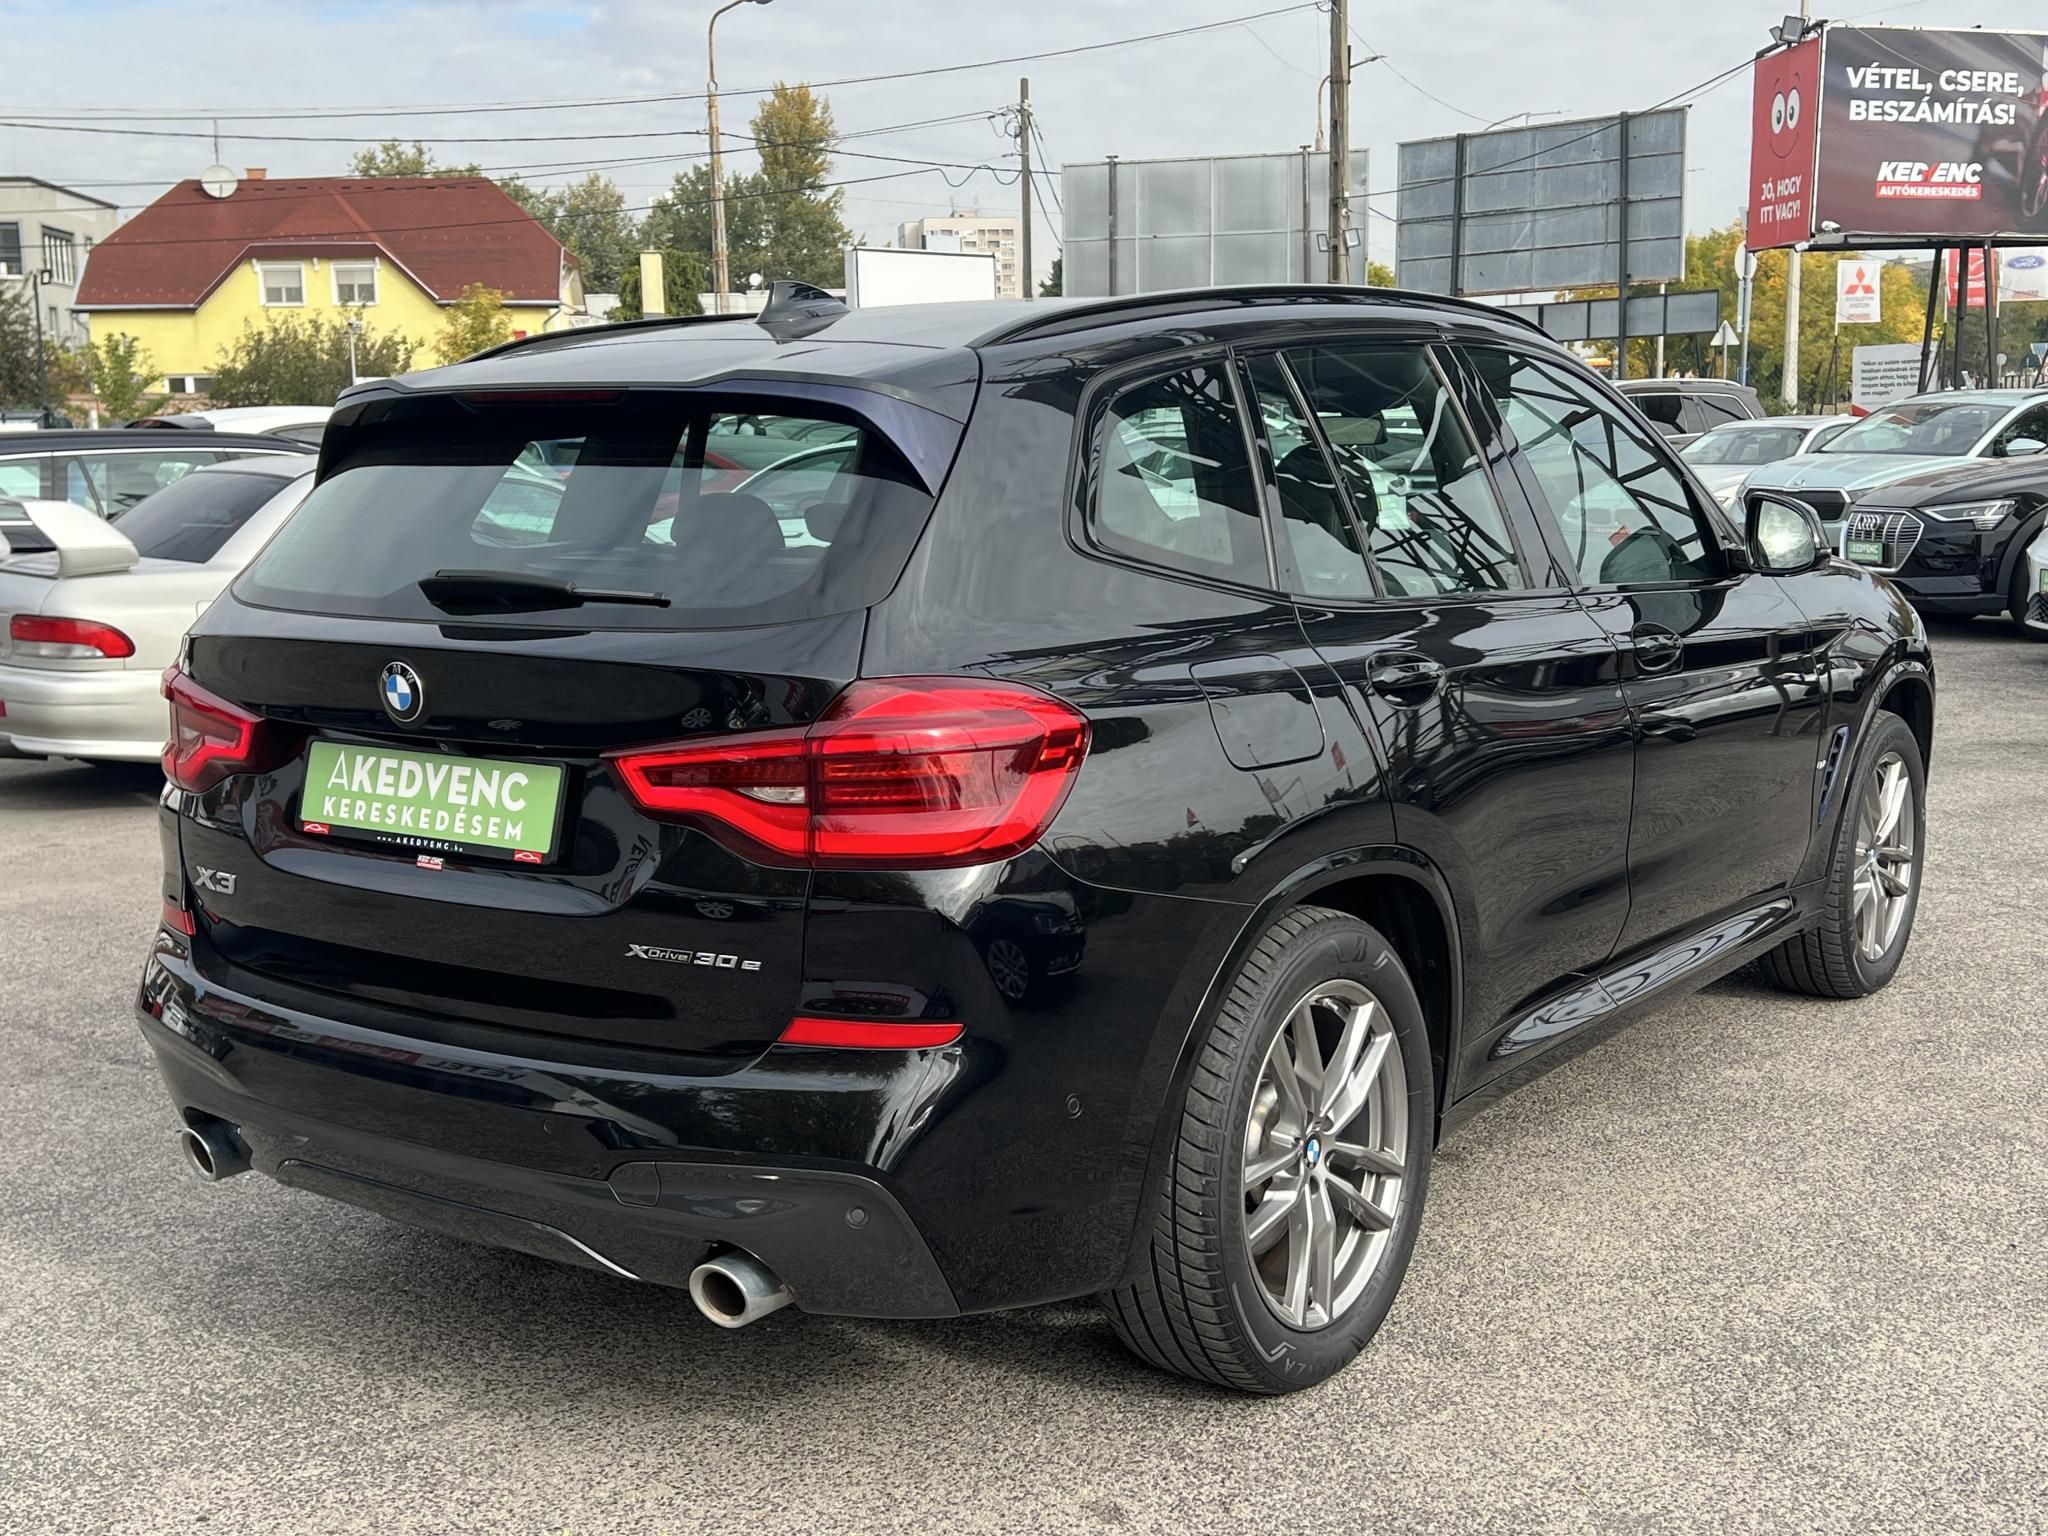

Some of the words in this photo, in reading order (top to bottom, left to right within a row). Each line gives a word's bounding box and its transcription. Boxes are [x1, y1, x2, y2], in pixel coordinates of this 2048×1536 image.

[1846, 61, 1933, 95] VÉTEL,
[1939, 69, 2025, 98] CSERE,
[1849, 96, 2017, 125] BESZÁMÍTÁS!
[1760, 177, 1775, 202] JÓ,
[1776, 174, 1802, 198] HOGY
[1879, 184, 1979, 197] AUTÓKERESKEDÉS
[1760, 205, 1774, 225] ITT
[1775, 199, 1801, 221] VAGY!
[381, 664, 416, 685] BMW
[323, 795, 524, 842] KERESKEDÉSEM
[194, 865, 238, 895] X3
